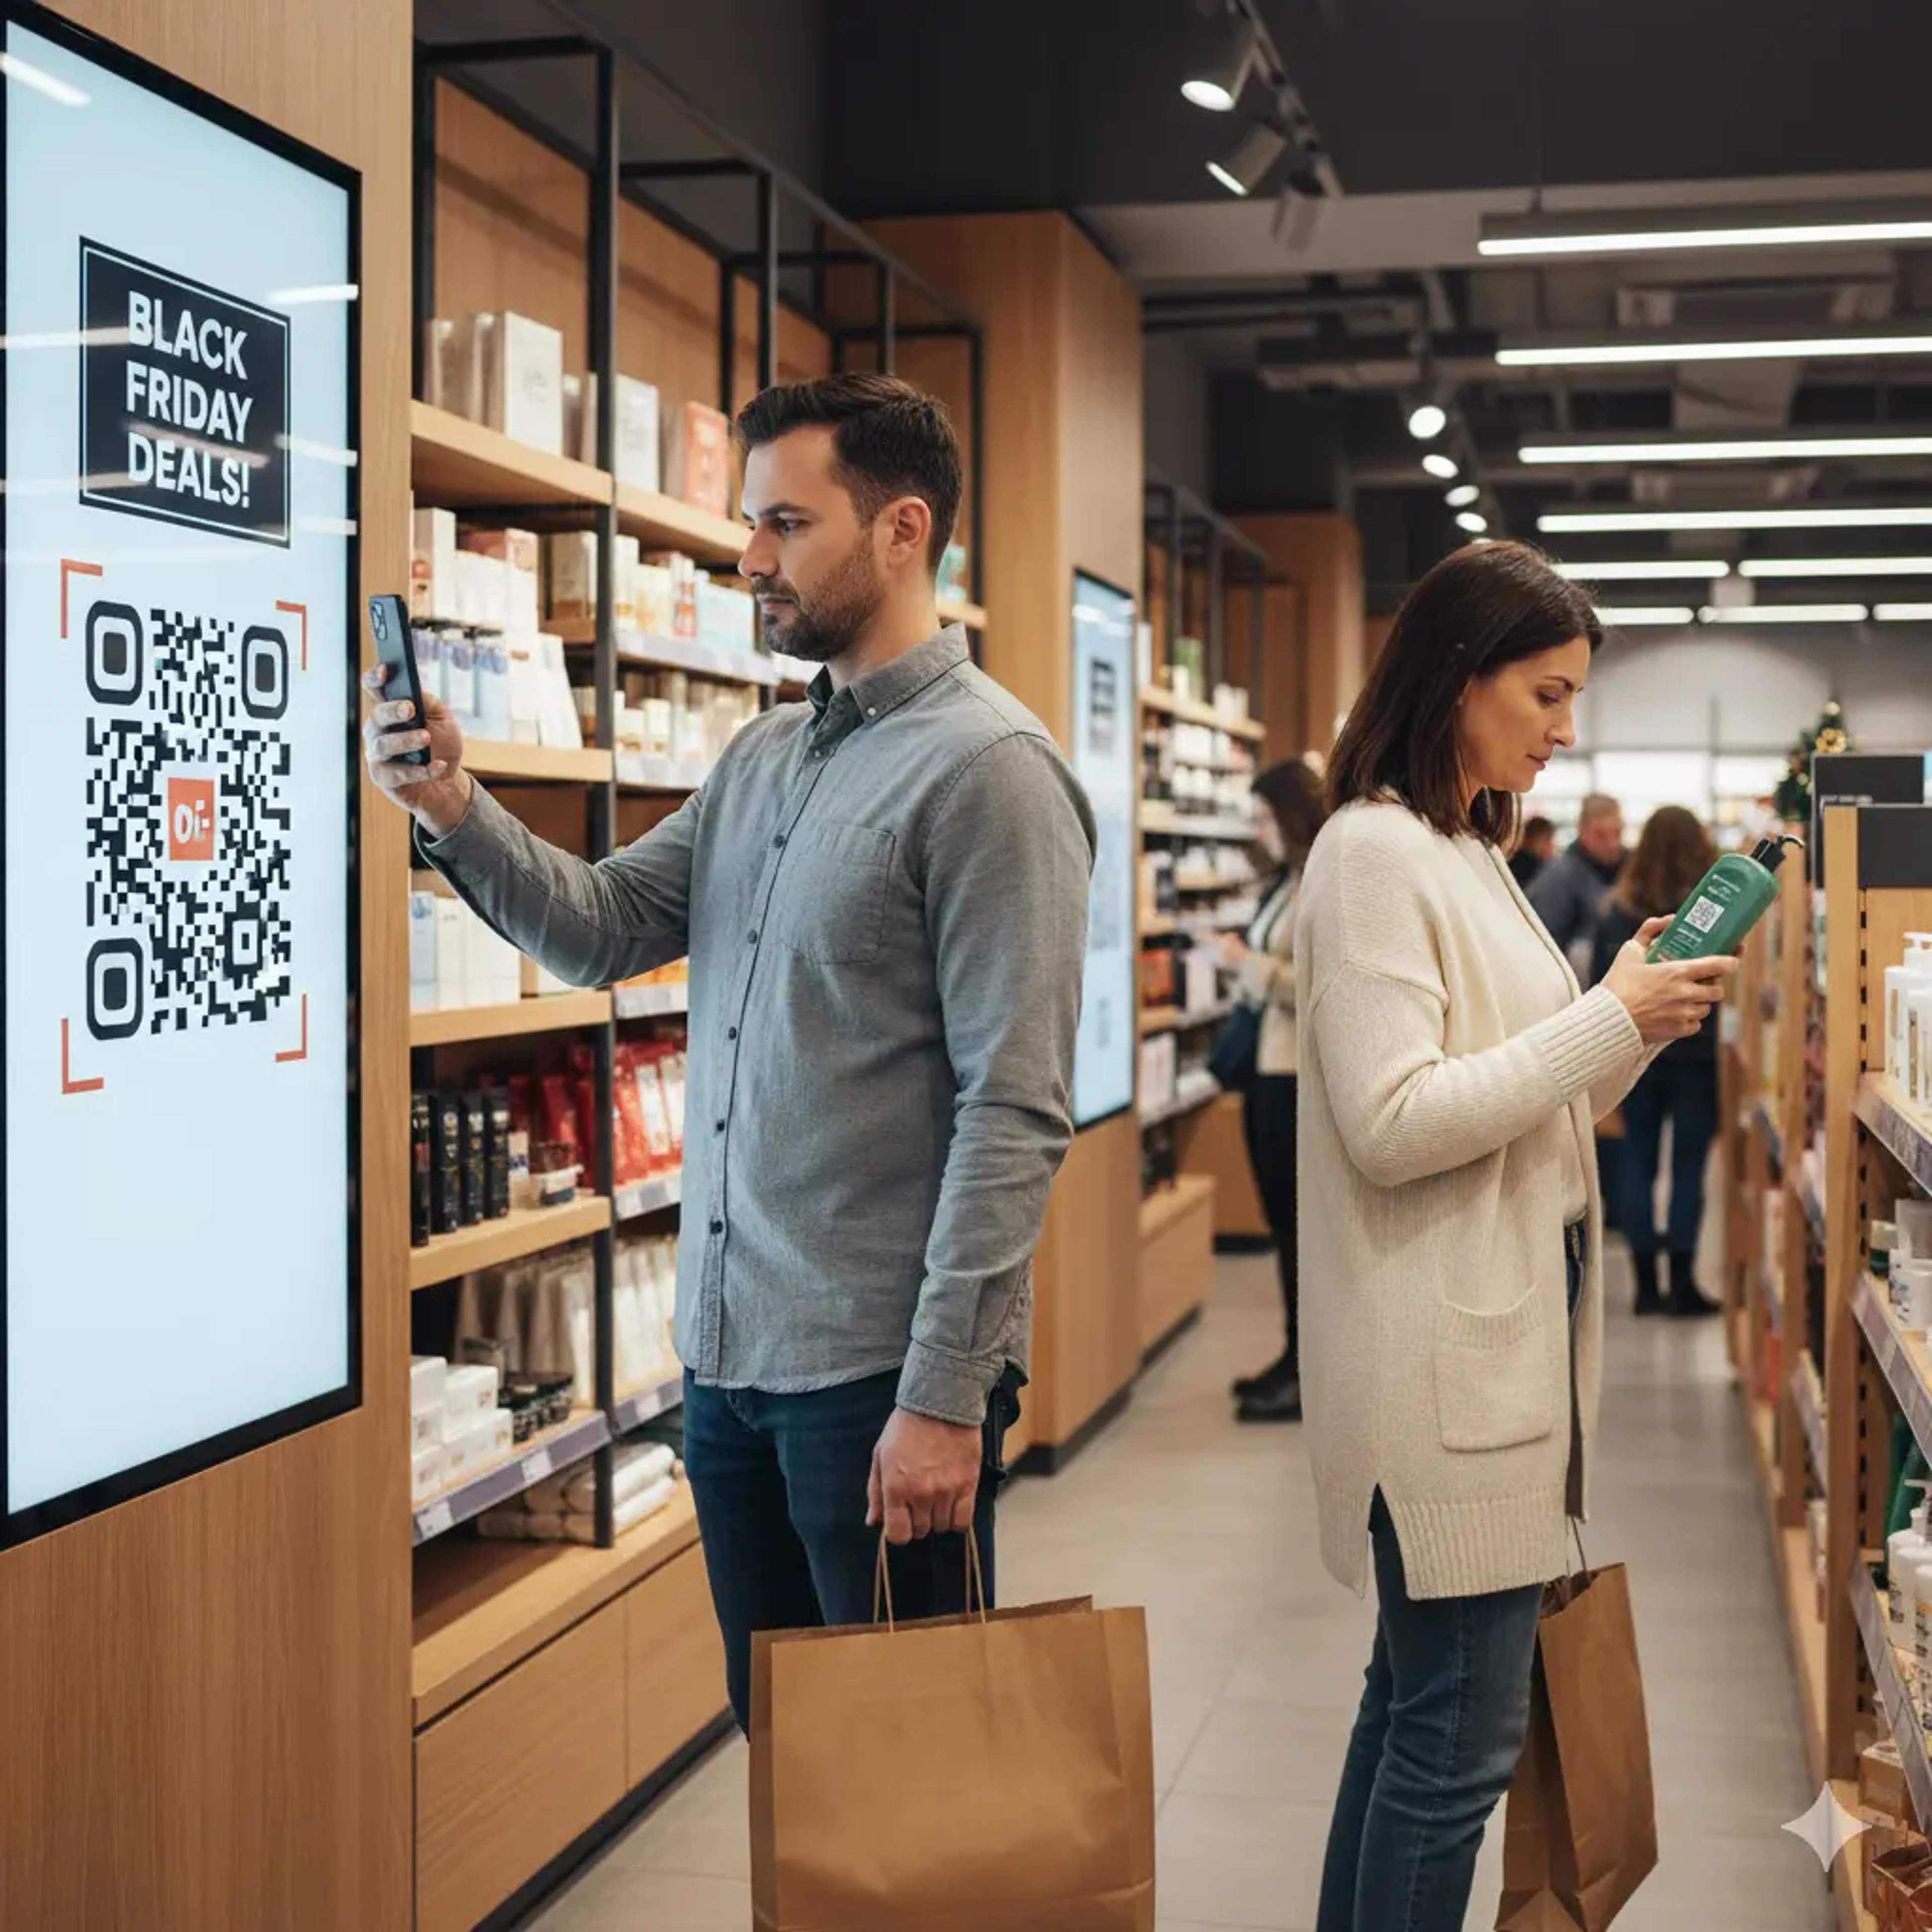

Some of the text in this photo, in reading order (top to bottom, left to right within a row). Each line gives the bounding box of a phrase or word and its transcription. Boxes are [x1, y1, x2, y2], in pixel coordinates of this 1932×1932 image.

[128, 290, 248, 380] BLACK
[125, 361, 253, 444] FRIDAY
[128, 432, 251, 508] DEALS!
